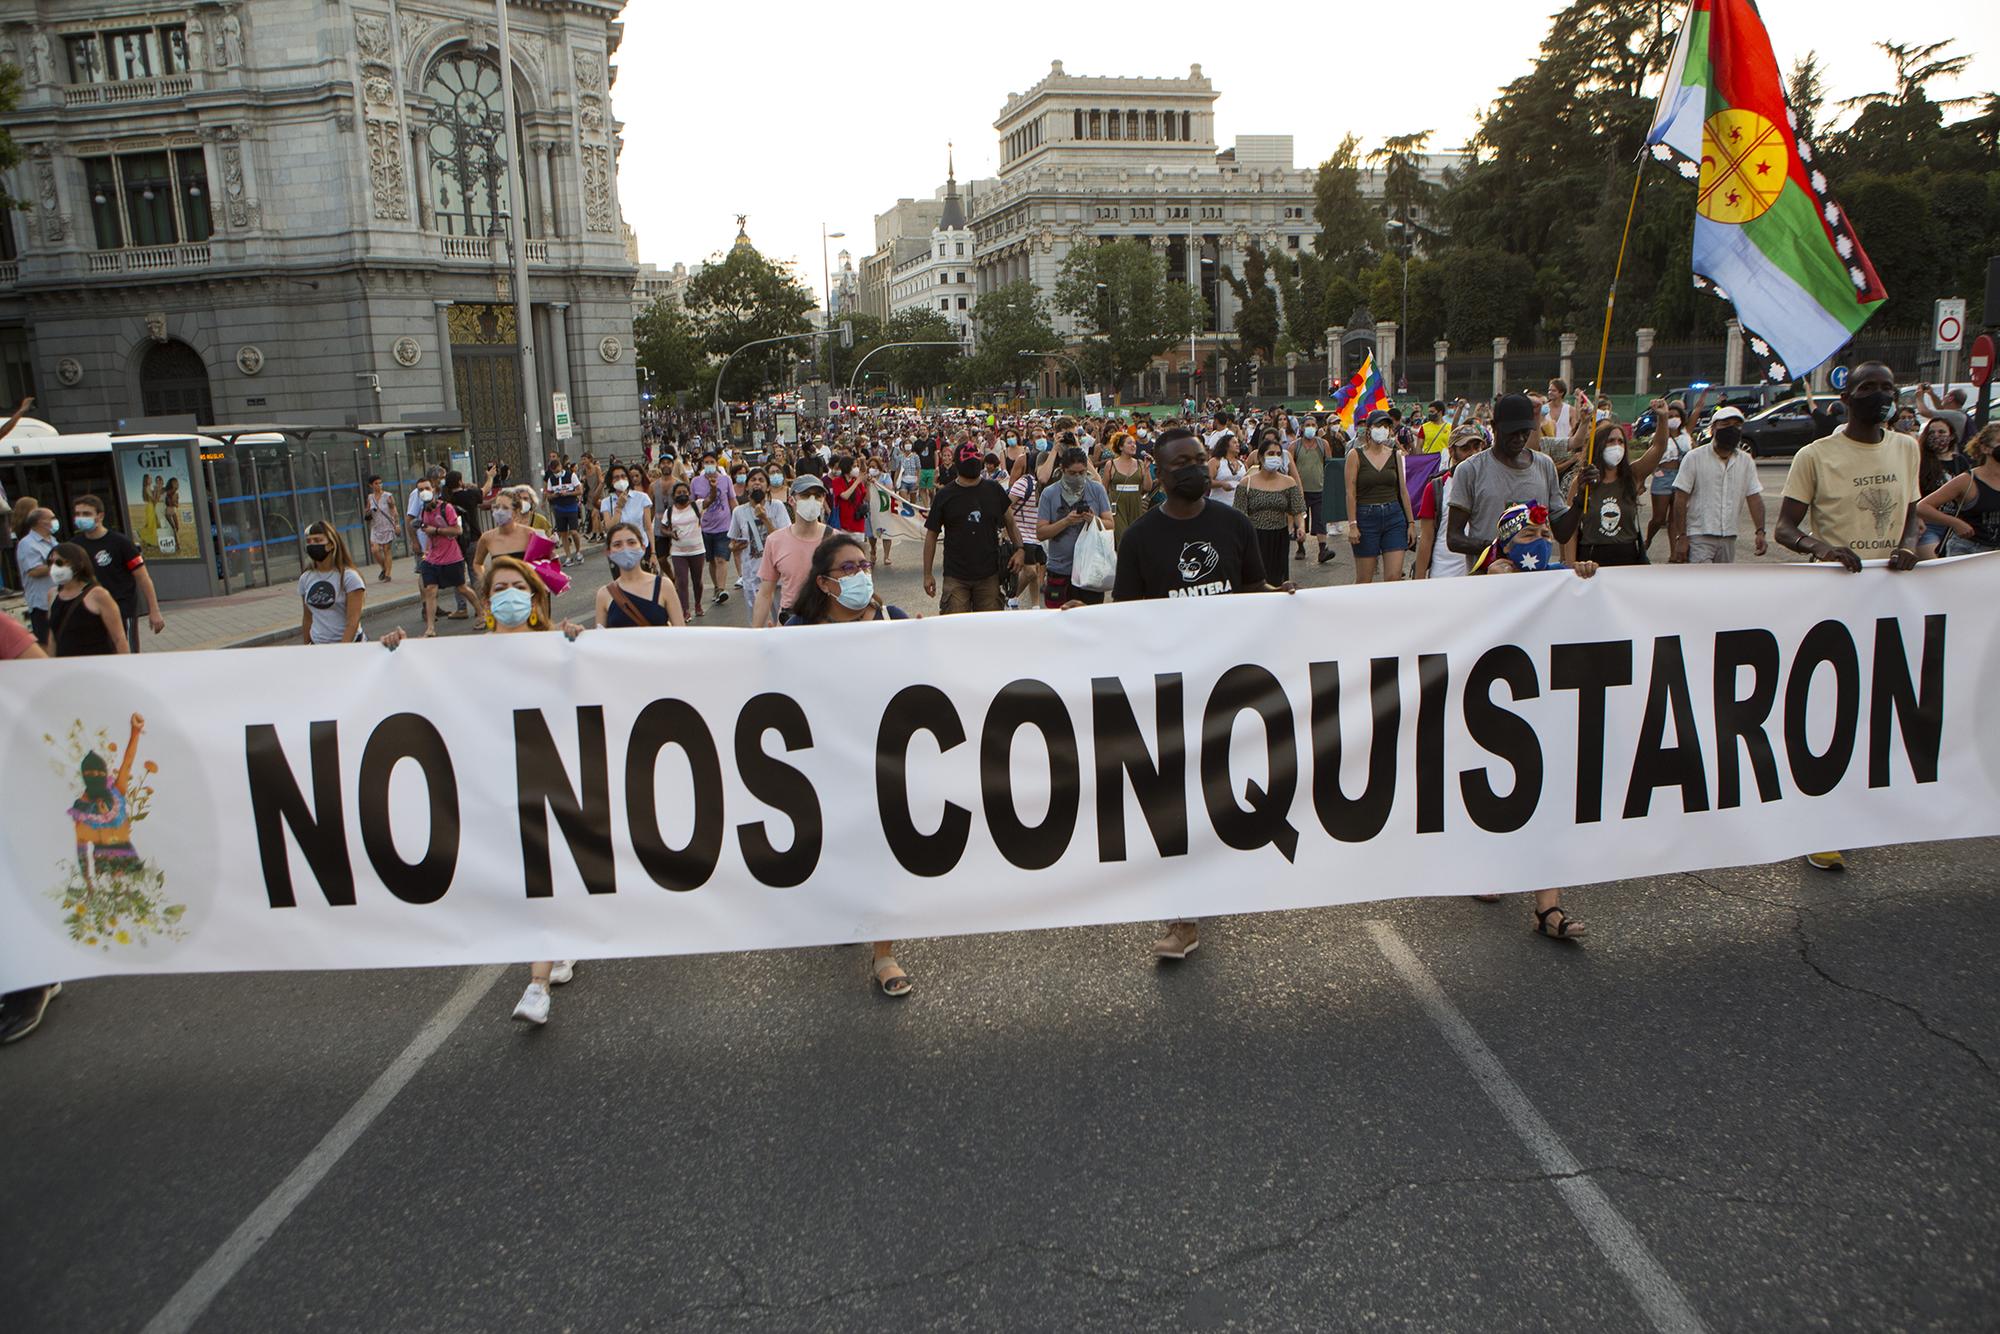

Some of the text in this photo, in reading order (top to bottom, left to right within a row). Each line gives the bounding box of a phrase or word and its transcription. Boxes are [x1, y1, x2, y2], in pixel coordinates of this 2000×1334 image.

[138, 450, 171, 468] Girl
[1853, 474, 1897, 487] SISTEMA
[1168, 579, 1232, 599] PANTERA
[245, 613, 1946, 908] NO NOS CONQUISTARON
